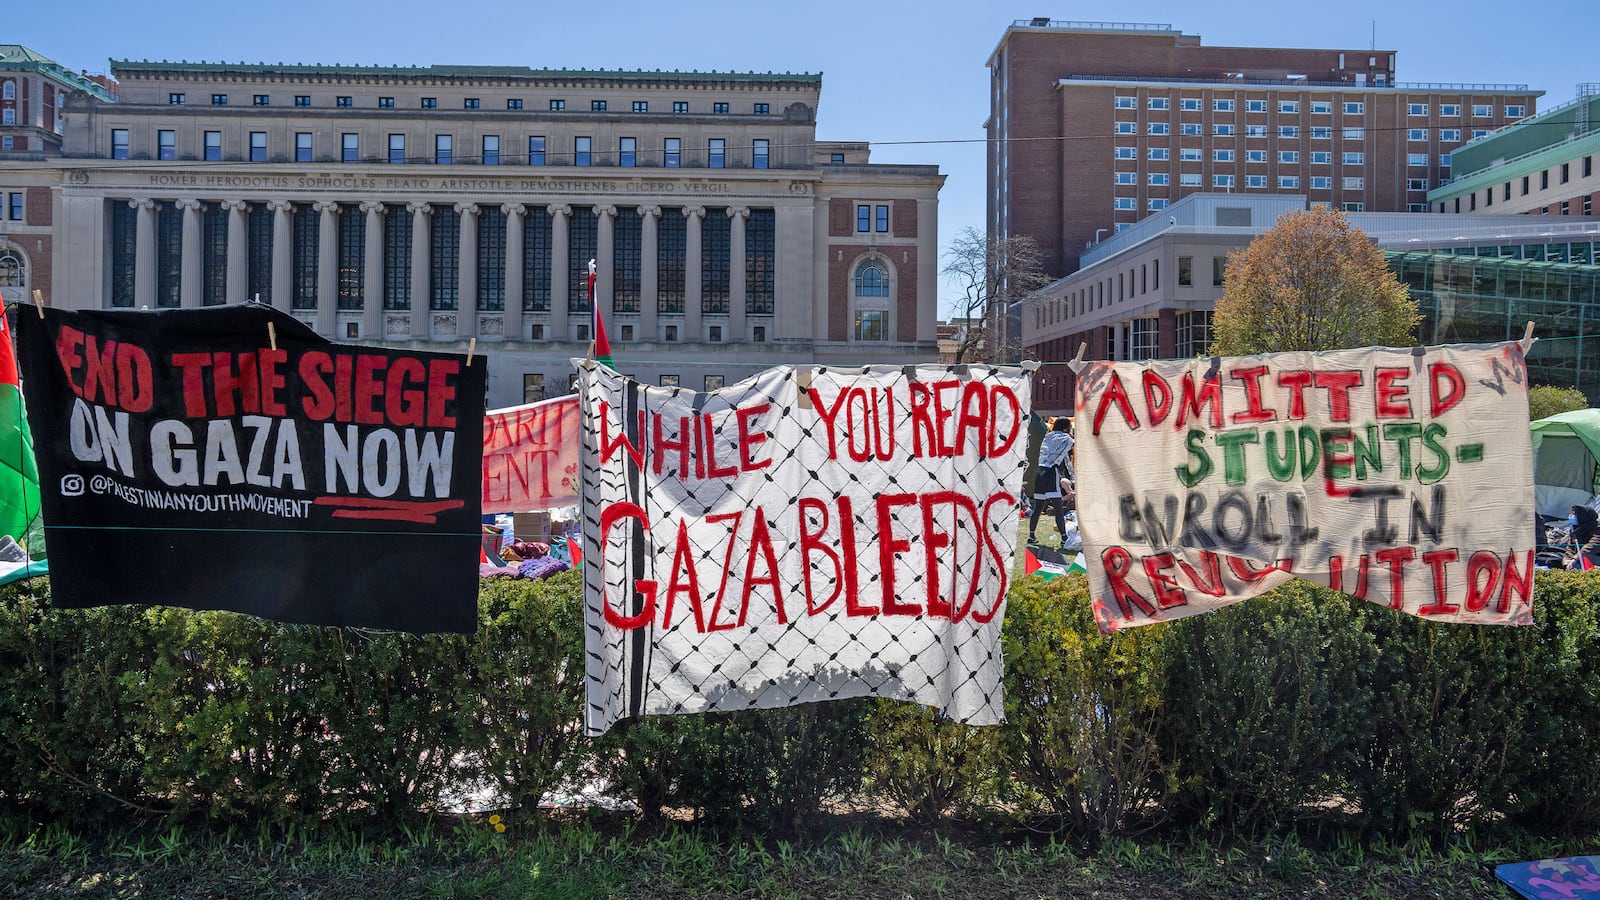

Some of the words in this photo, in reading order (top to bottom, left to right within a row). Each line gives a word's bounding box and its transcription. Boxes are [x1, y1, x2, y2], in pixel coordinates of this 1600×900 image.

[150, 175, 198, 186] HOMER
[206, 176, 289, 188] HERODOTUS
[298, 177, 376, 188] SOPHOCLES
[386, 178, 430, 189] PLATO
[440, 179, 513, 190] ARISTOTLE
[520, 180, 617, 192] DEMOSTHENES
[625, 182, 675, 193] CICERO
[684, 182, 731, 193] VERGIL
[56, 324, 153, 413] END
[171, 347, 287, 418] THE
[299, 351, 460, 428] SIEGE
[1093, 361, 1466, 437] ADMITTED
[70, 398, 135, 478] ON
[150, 415, 306, 491] GAZA
[323, 423, 456, 499] NOW
[598, 401, 773, 481] WHILE
[806, 385, 897, 463] YOU
[908, 379, 1021, 459] READ
[90, 474, 313, 519] @PALESTINIANYOUTHMOVEMENT
[1118, 489, 1319, 550] ENROLL
[1350, 484, 1444, 546] IN
[600, 501, 788, 634] GAZA
[799, 490, 1018, 624] BLEEDS
[1100, 545, 1534, 622] REVUTION
